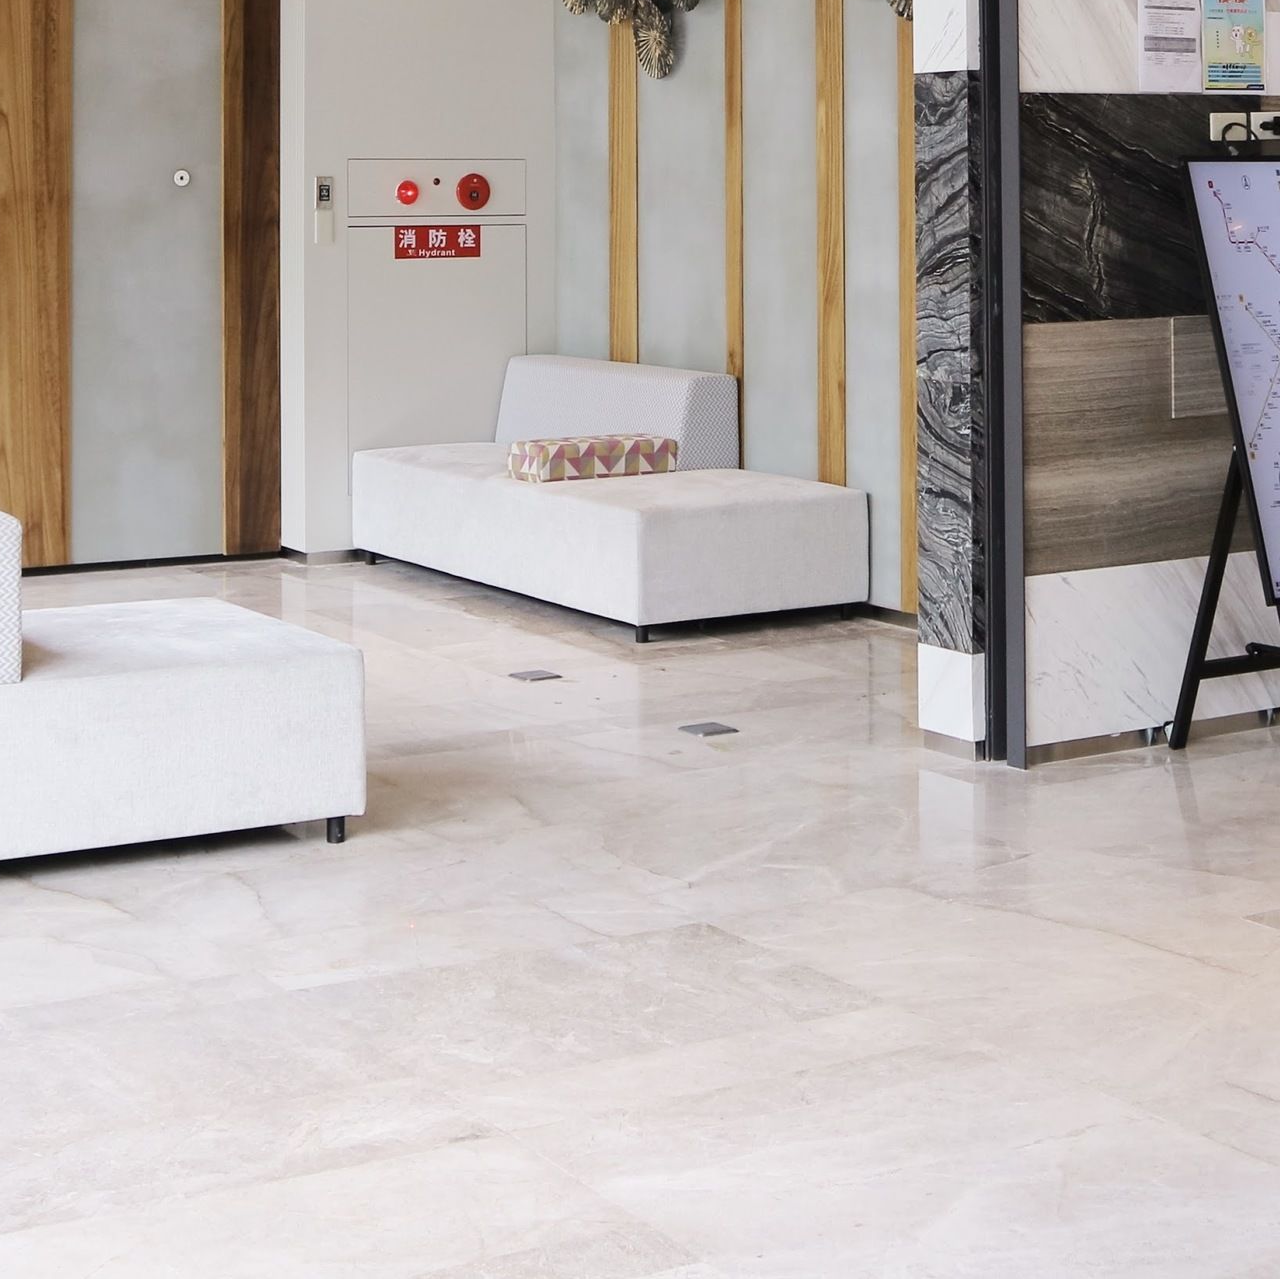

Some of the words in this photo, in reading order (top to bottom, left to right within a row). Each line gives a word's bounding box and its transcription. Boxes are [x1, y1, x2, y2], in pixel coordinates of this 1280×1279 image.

[399, 228, 476, 248] 消防栓
[418, 249, 456, 258] Hydrant
